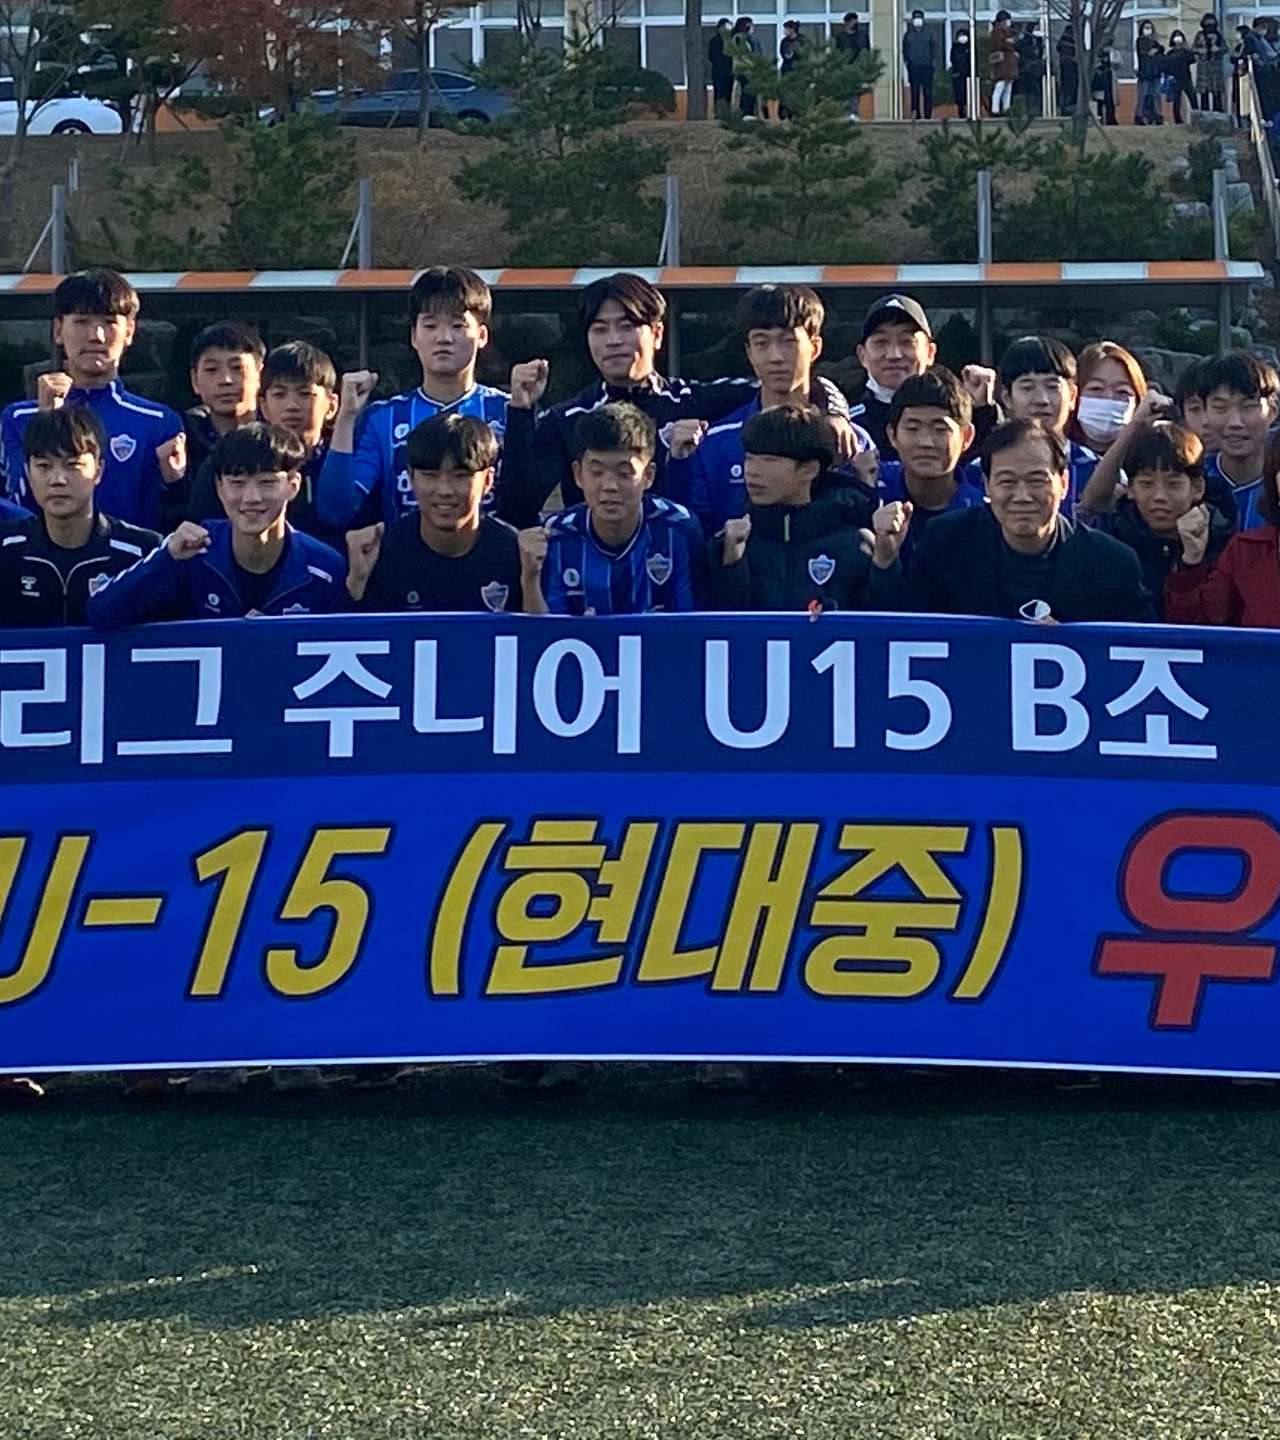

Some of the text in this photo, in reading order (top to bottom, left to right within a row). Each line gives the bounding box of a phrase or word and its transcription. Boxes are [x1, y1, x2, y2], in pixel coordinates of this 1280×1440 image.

[284, 635, 642, 758] 주니어
[705, 639, 953, 751] U15
[1010, 643, 1218, 760] B조
[427, 818, 1024, 1000] (현대중)
